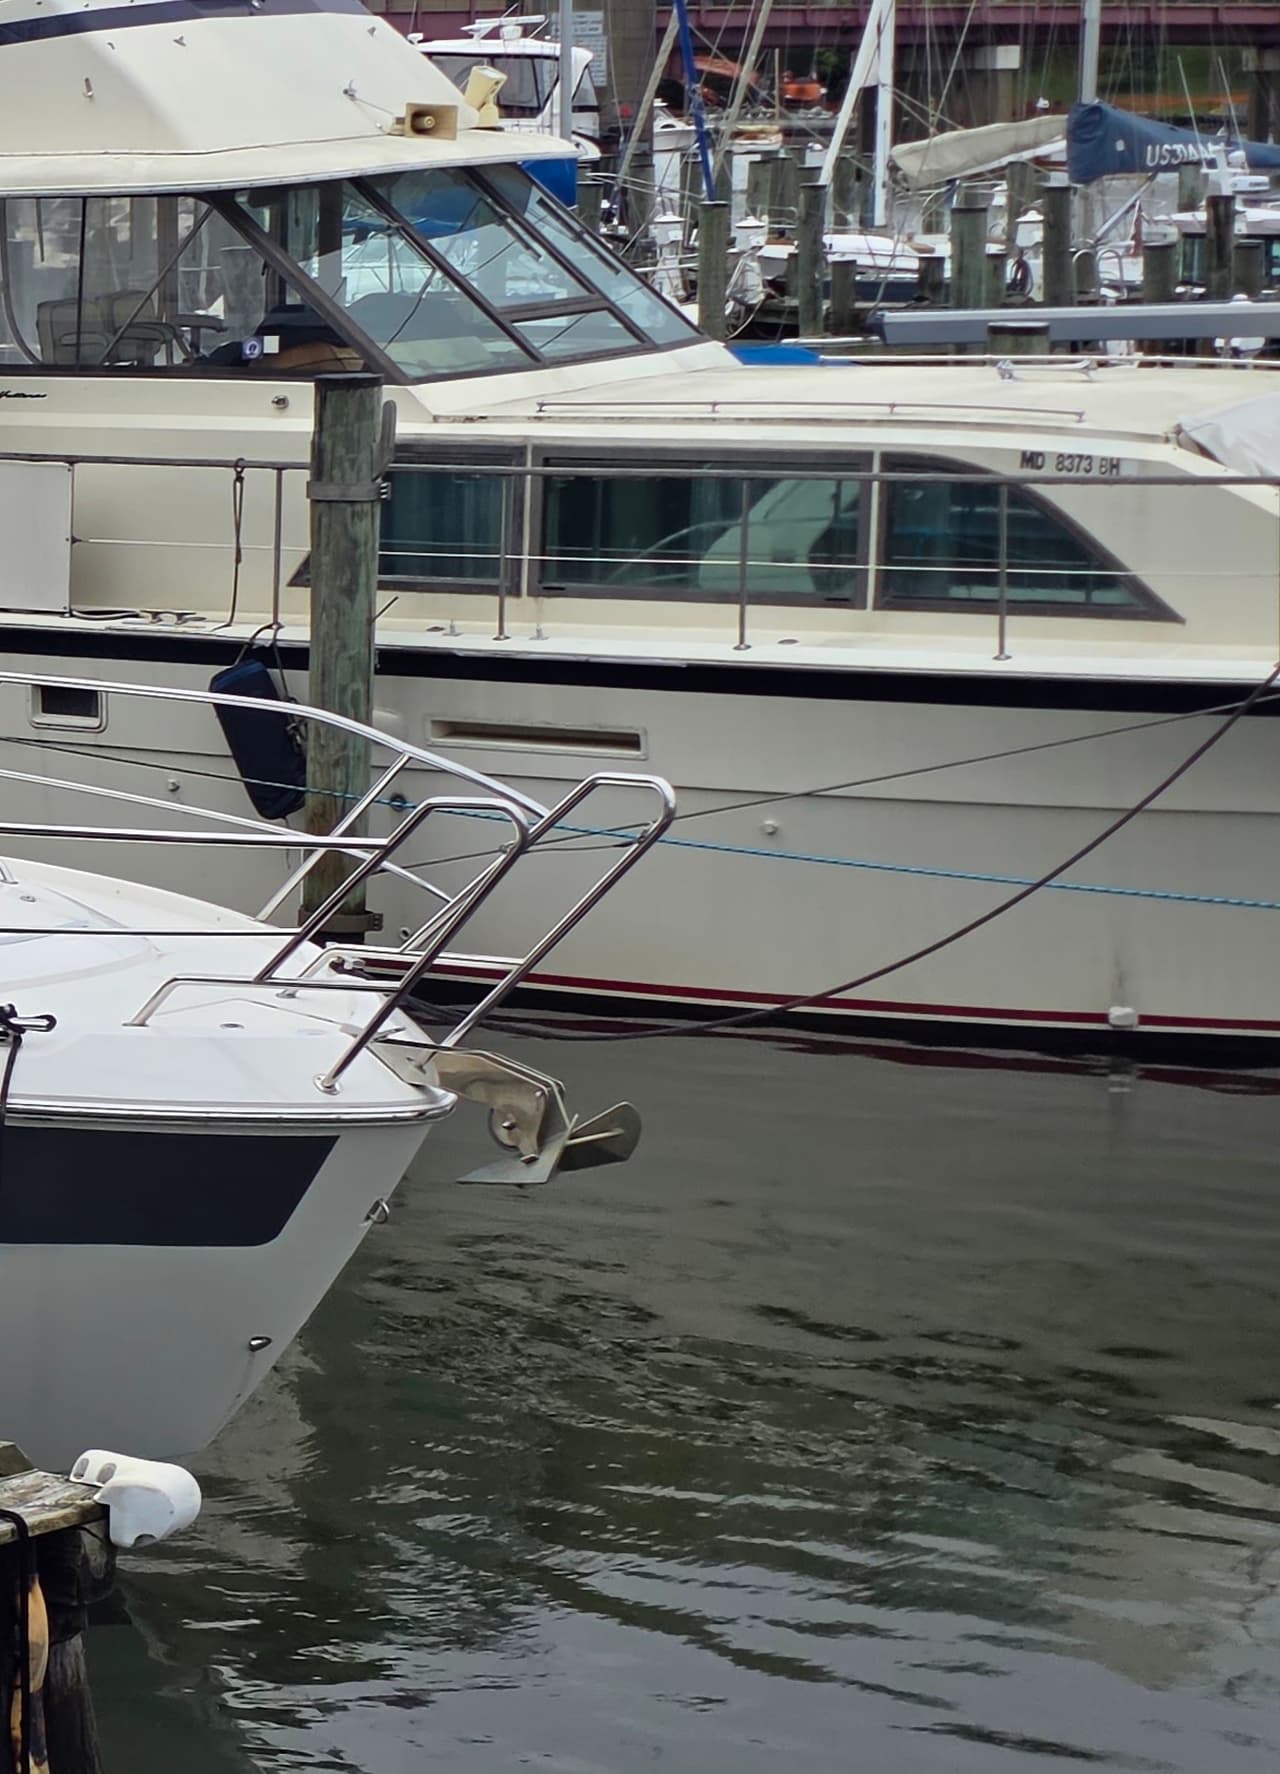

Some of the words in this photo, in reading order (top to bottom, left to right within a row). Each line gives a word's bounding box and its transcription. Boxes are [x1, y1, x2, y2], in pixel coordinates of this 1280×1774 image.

[1020, 450, 1046, 471] MD
[1055, 453, 1093, 474] 8373
[1099, 457, 1120, 476] BH
